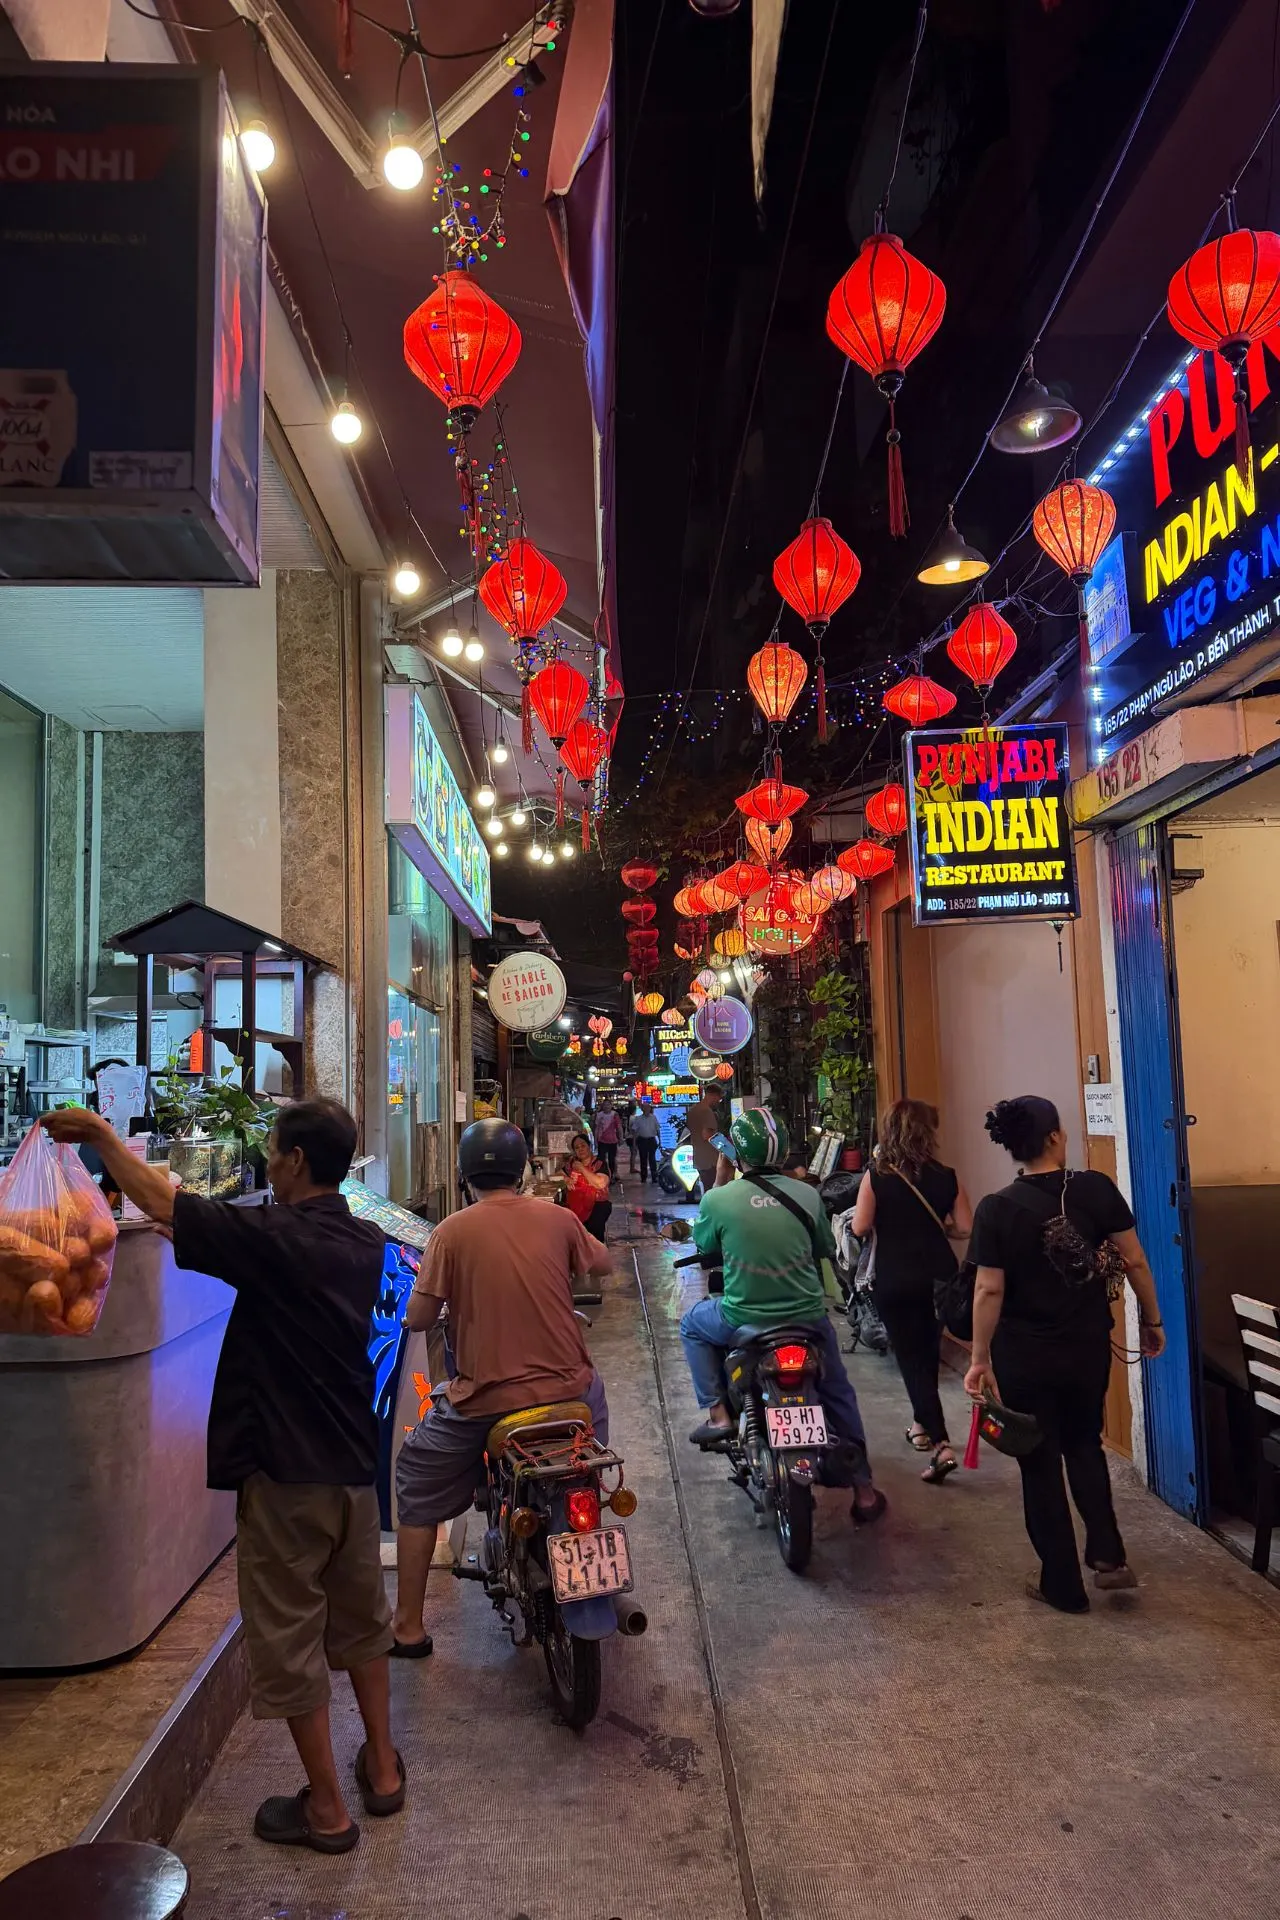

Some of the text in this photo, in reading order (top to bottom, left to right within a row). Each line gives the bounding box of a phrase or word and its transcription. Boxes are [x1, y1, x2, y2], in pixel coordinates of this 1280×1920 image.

[56, 148, 135, 181] NHI
[1144, 446, 1256, 603] INDIAN
[1163, 576, 1216, 648] VEG
[1226, 549, 1250, 602] &
[1104, 709, 1129, 736] 185/22
[1129, 689, 1152, 715] PHẠM
[1153, 670, 1173, 702] NGŨ
[1197, 652, 1207, 671] P.
[1208, 631, 1229, 664] BẾN
[1229, 604, 1272, 647] THÀNH,
[917, 738, 1059, 793] PUNJABI
[1122, 743, 1142, 790] 22
[923, 797, 1061, 855] INDIAN
[925, 861, 1066, 887] RESTAURANT
[927, 898, 947, 911] ADD:
[949, 897, 977, 910] 185/22
[978, 895, 1002, 911] PHẠM
[1003, 892, 1020, 906] NGŨ
[1021, 892, 1037, 907] LÃO
[1043, 892, 1062, 906] DIST
[1064, 892, 1070, 904] 1
[514, 969, 547, 986] TABLE
[514, 983, 554, 1002] SAIGON
[774, 1407, 815, 1426] 59-H1
[771, 1426, 825, 1446] 759.23
